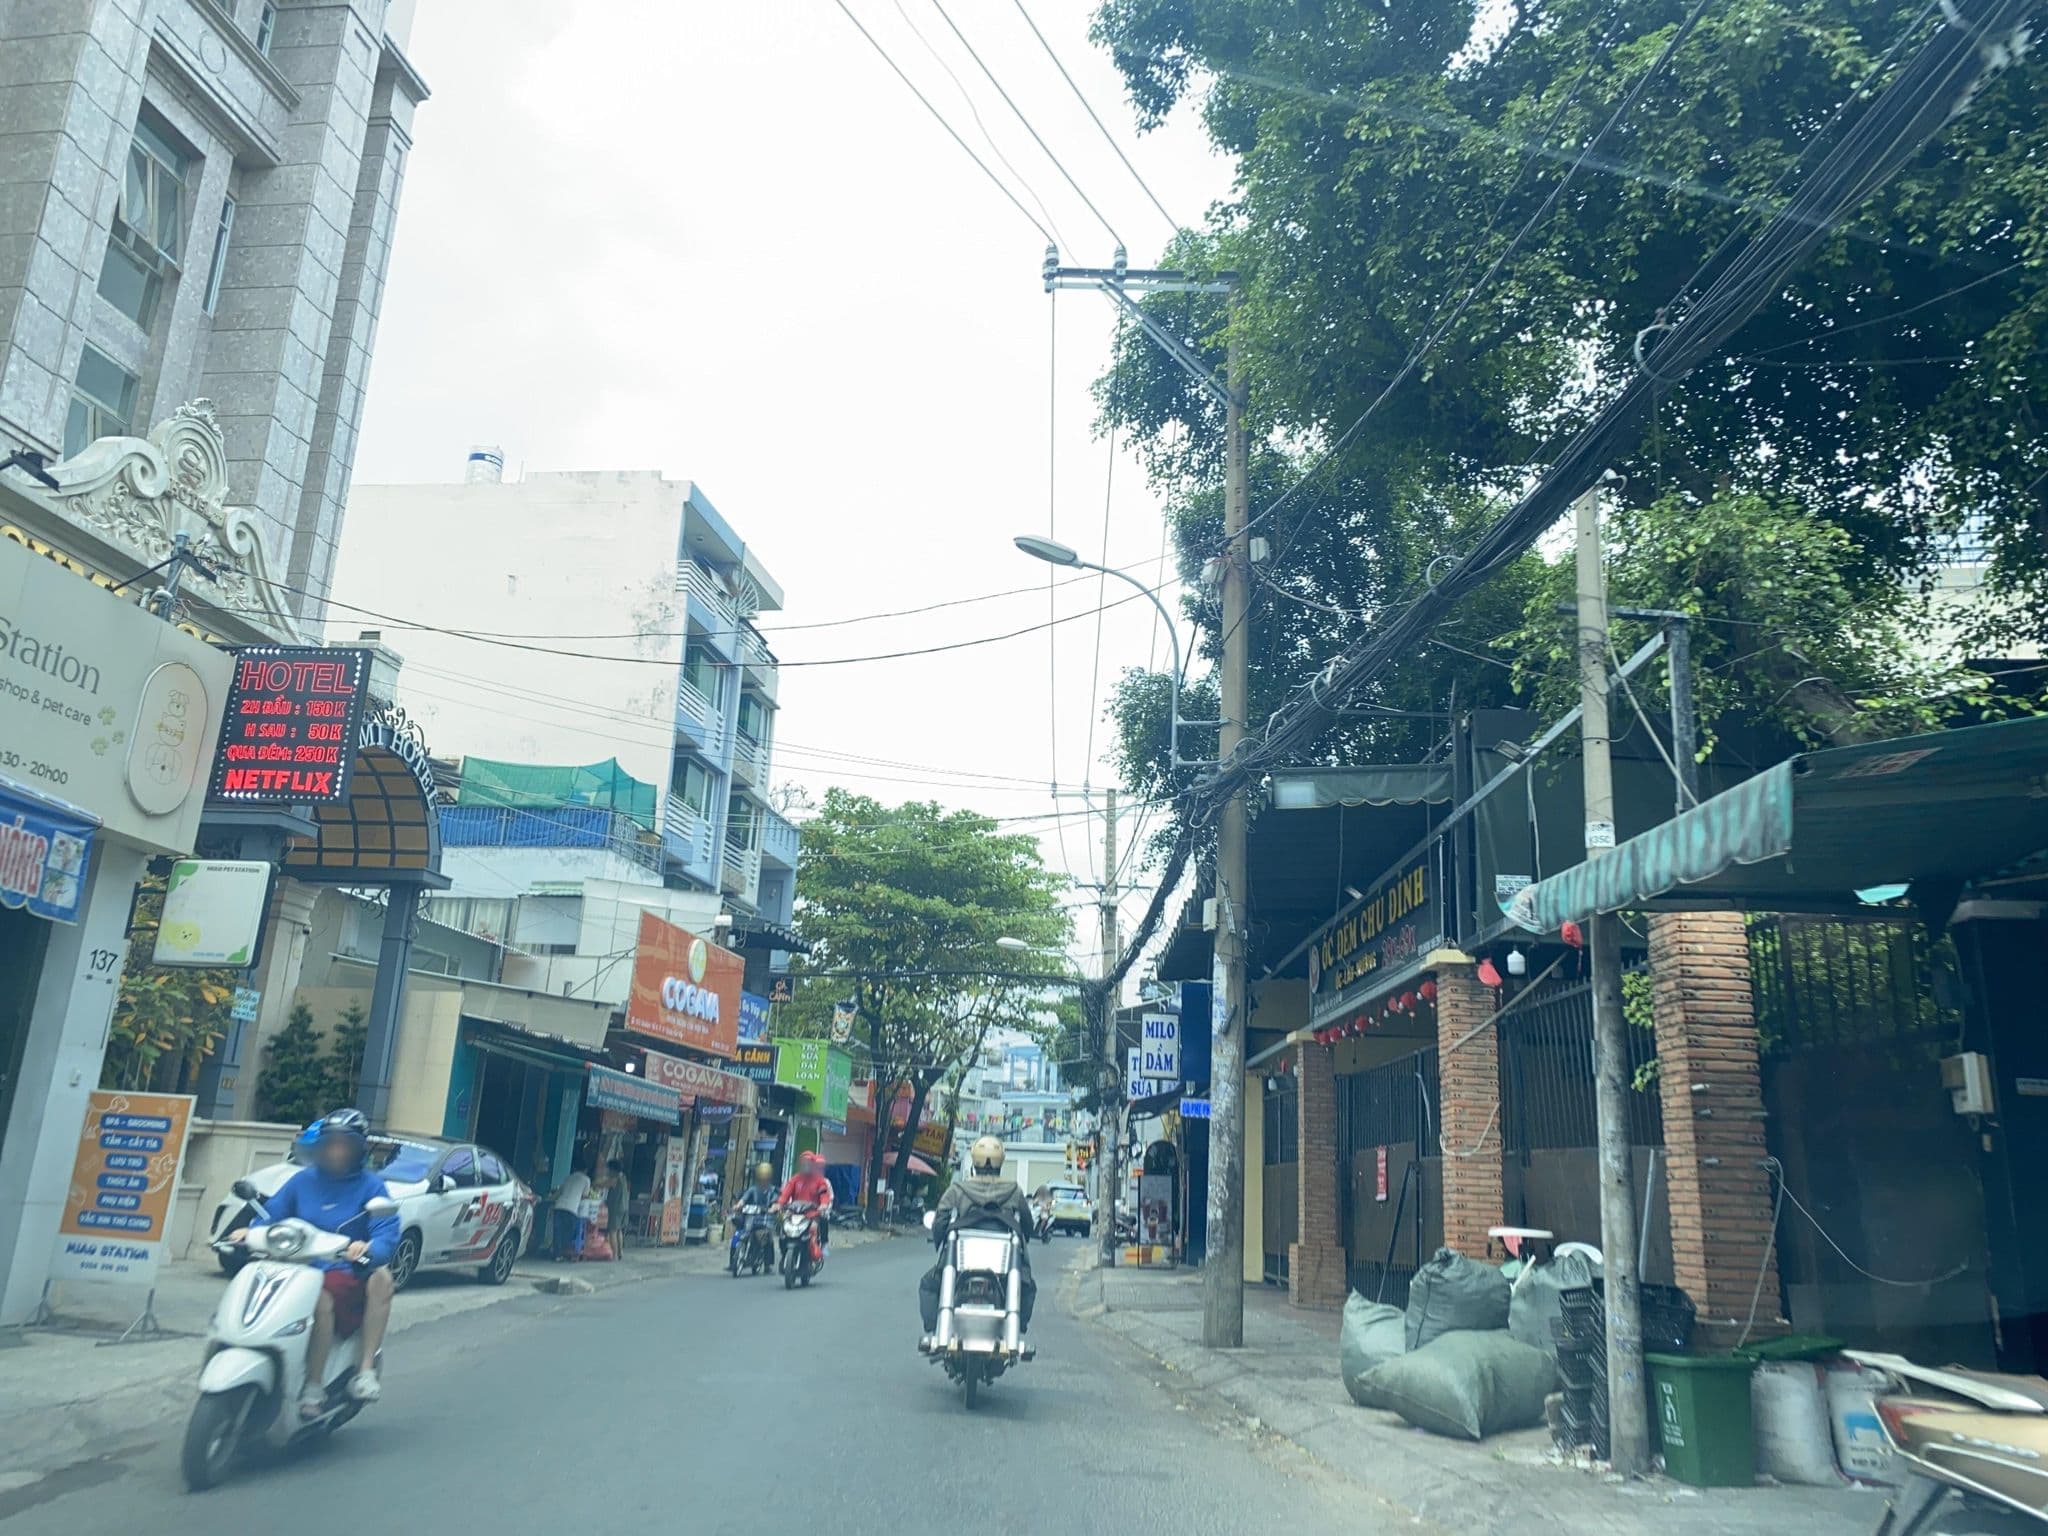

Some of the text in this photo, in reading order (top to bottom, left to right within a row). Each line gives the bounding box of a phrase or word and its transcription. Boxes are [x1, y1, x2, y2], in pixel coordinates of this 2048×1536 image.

[240, 660, 353, 694] HOTEL
[31, 690, 40, 704] &
[42, 698, 64, 715] pet
[65, 706, 92, 726] care
[258, 723, 287, 738] SAU
[0, 751, 20, 768] 30
[30, 761, 69, 785] 20h00
[389, 731, 438, 810] HOTEL
[224, 769, 332, 794] NETFLIX
[90, 949, 118, 973] 137
[662, 975, 720, 1025] COGAVA
[1146, 1021, 1175, 1039] MILO
[663, 1060, 724, 1090] COGAVA
[750, 1067, 772, 1080] SINH
[796, 1071, 820, 1080] LOAN
[105, 1116, 120, 1126] SPA
[100, 1244, 150, 1261] STATION
